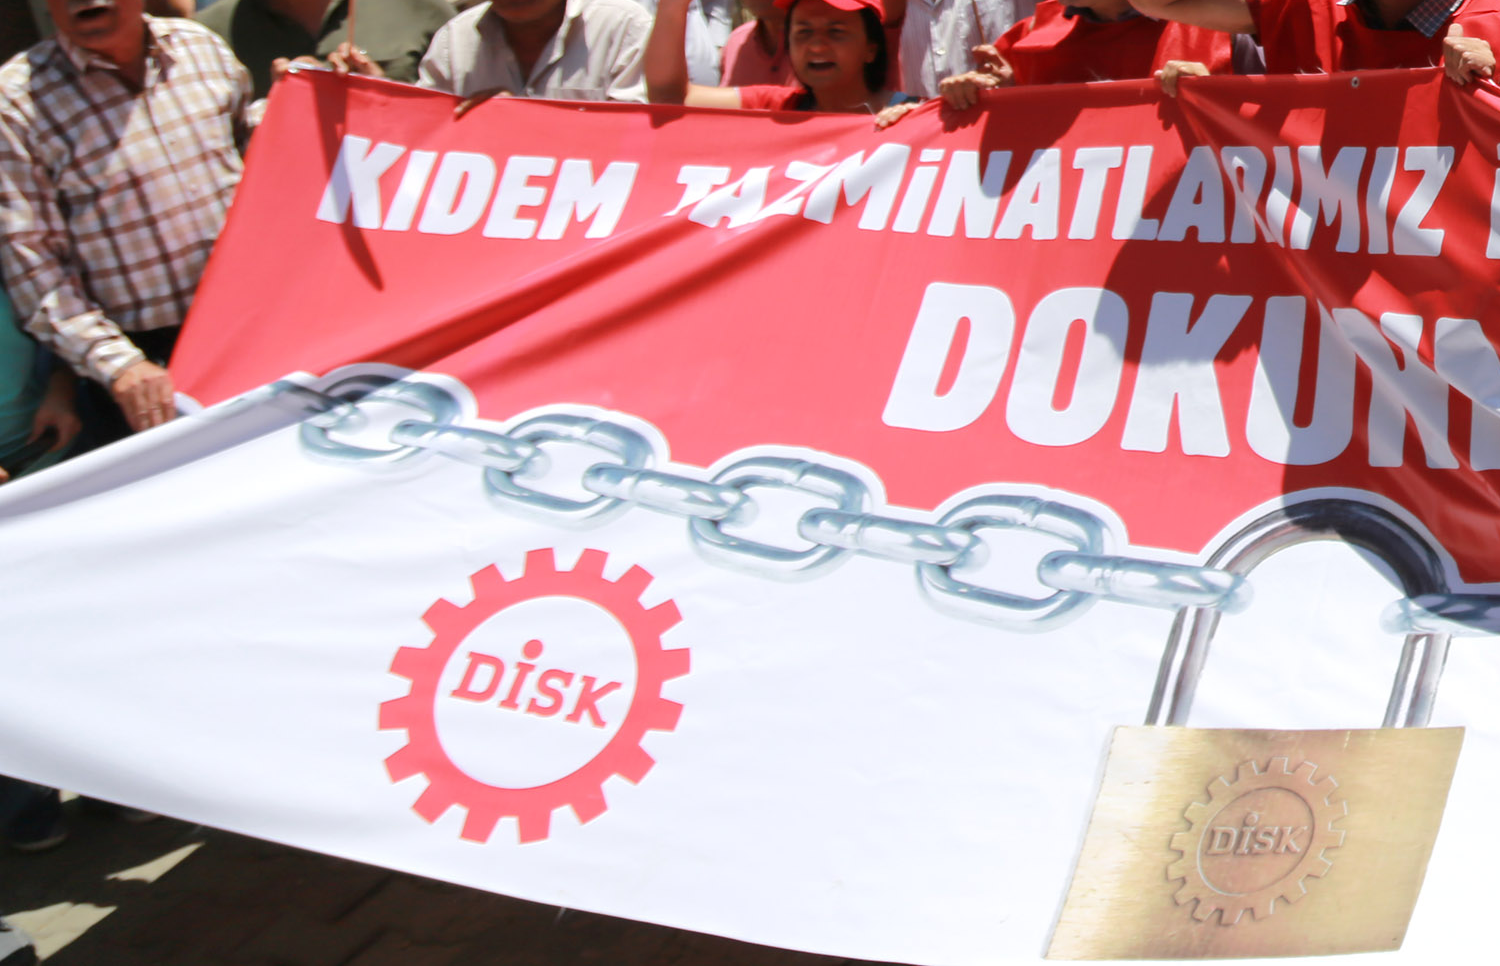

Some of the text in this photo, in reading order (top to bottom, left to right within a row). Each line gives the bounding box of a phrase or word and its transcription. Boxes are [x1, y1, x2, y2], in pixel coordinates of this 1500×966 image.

[316, 134, 639, 240] KIDEM
[663, 142, 1455, 257] TAZMİNATLARIMIZ
[450, 638, 623, 729] DİSK
[1205, 812, 1308, 856] DİSK
